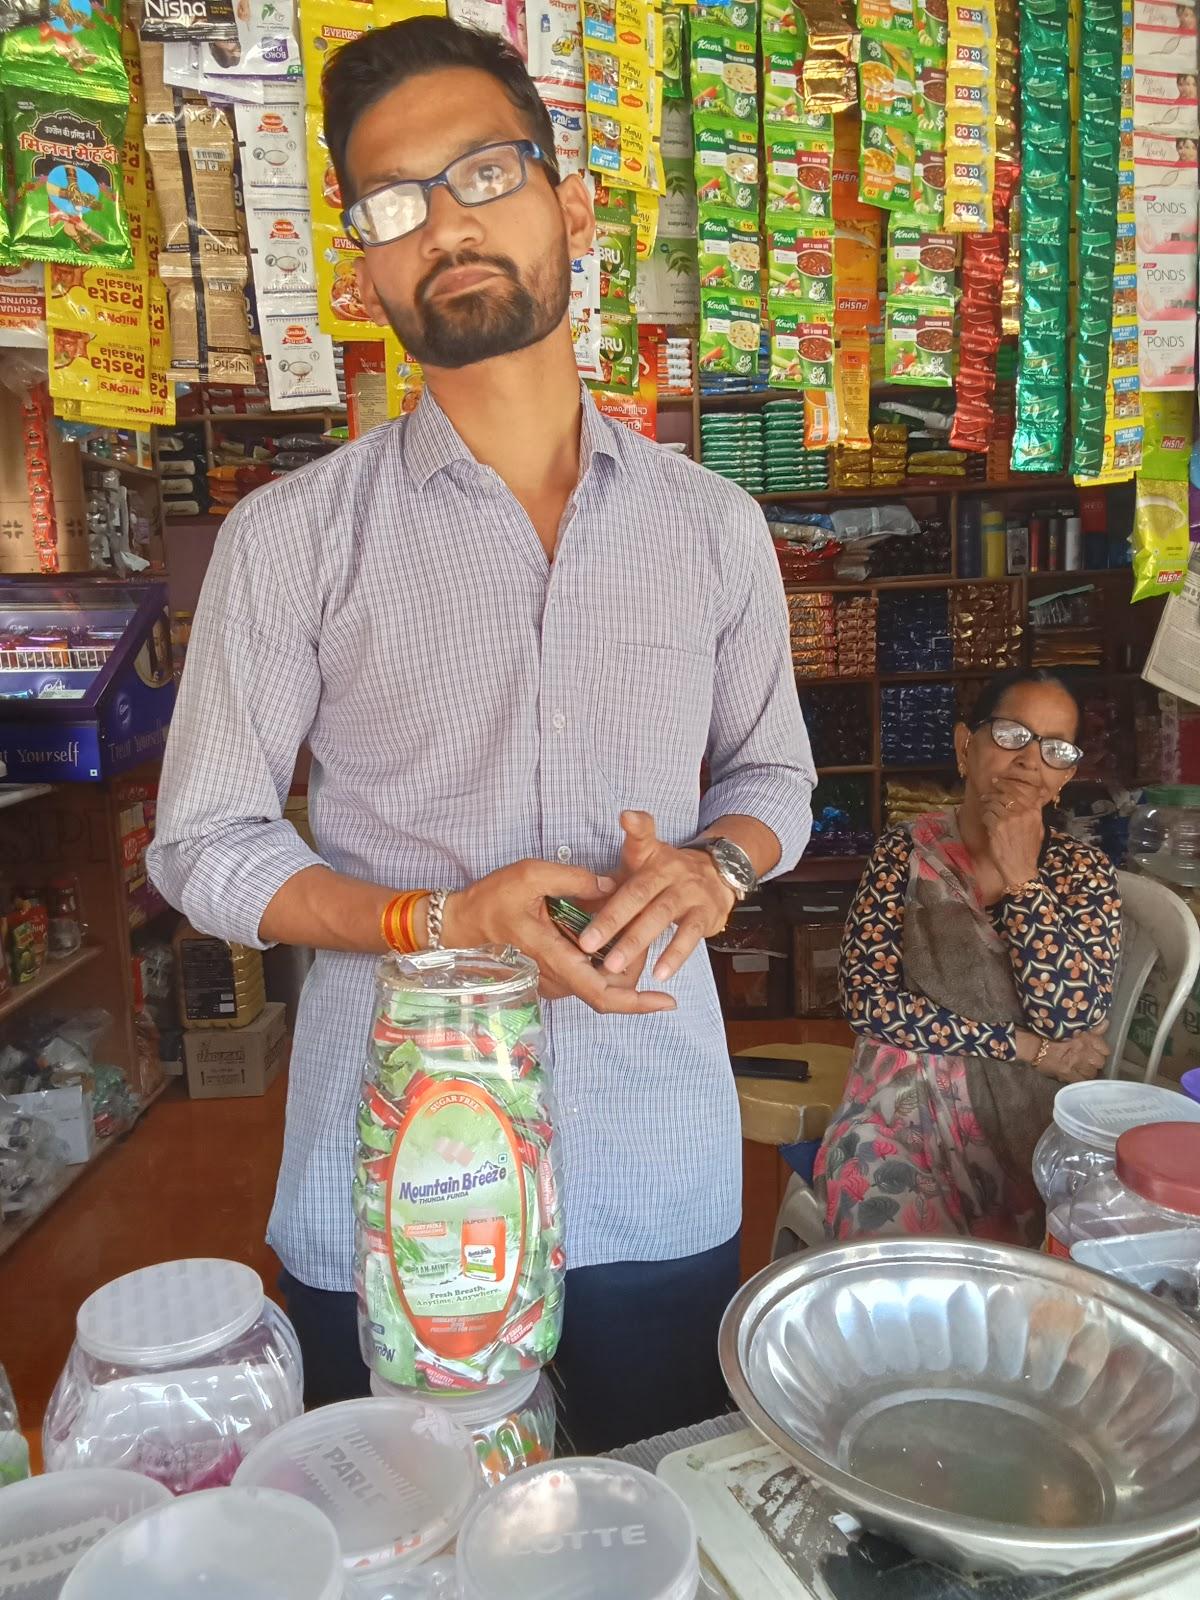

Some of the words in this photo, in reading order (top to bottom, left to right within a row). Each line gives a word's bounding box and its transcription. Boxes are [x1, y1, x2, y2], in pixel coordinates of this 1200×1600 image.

[145, 0, 207, 17] Nisha
[959, 9, 970, 19] 20
[971, 11, 981, 21] 20
[697, 39, 723, 52] Knorr
[959, 47, 970, 58] 20
[971, 50, 981, 60] 20
[770, 55, 794, 67] Knorr
[957, 87, 969, 98] 20
[970, 89, 981, 99] 20
[700, 131, 724, 144] Knorr
[957, 126, 968, 137] 20
[969, 128, 980, 138] 20
[18, 131, 73, 160] मिलन
[772, 145, 796, 155] Knorr
[832, 171, 859, 182] USHP
[956, 165, 967, 176] 20
[968, 166, 979, 177] 20
[1146, 202, 1187, 215] POND'S
[703, 221, 728, 233] Knorr
[773, 232, 795, 243] Knorr
[894, 229, 920, 239] Knorr
[204, 241, 241, 256] Nisha
[600, 246, 621, 262] BRU
[1146, 269, 1187, 282] POND'S
[96, 277, 143, 293] Masala
[0, 296, 39, 305] CHUTNE
[87, 286, 144, 311] Pasta
[0, 305, 43, 315] SZECHUA
[706, 300, 729, 311] Knorr
[838, 302, 868, 311] PUSHP
[892, 311, 918, 322] Knorr
[775, 318, 797, 329] Knorr
[600, 335, 623, 352] BRU
[1147, 335, 1186, 348] POND'S
[100, 347, 145, 364] Masala
[91, 356, 145, 380] Pasta
[213, 358, 250, 372] Nisha
[601, 405, 627, 415] Powder
[1162, 438, 1186, 448] PUSHP
[1158, 573, 1184, 582] PUSHP
[18, 741, 80, 767] Yourself
[430, 1095, 458, 1112] SUGAR
[459, 1095, 480, 1109] FREE
[399, 1176, 460, 1204] Mountain
[462, 1166, 507, 1191] Breeze
[447, 1191, 469, 1201] FUNDA
[429, 1290, 453, 1299] Fresh
[456, 1288, 502, 1303] Anywhere.
